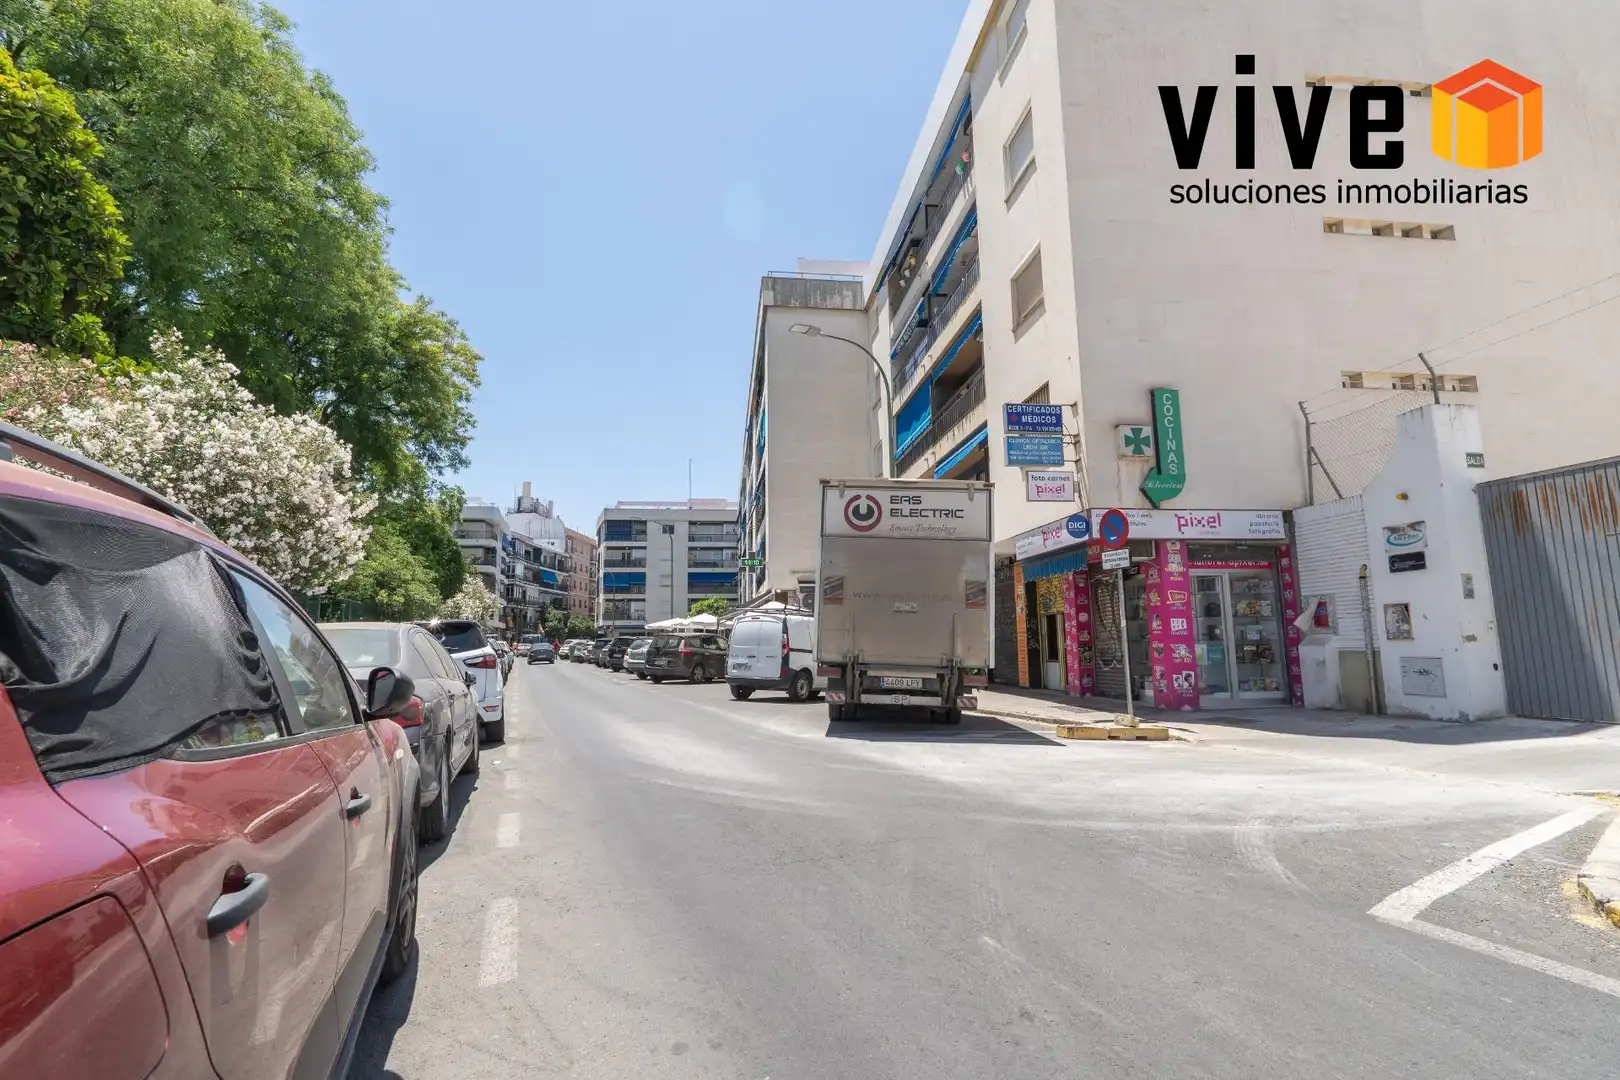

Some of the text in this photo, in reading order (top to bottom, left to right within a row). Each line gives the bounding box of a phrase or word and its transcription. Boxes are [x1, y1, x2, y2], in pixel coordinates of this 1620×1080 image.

[1007, 405, 1061, 414] CERTIFICADOS
[1021, 413, 1057, 423] MÉDICOS
[1163, 393, 1178, 475] COCINAS
[1035, 483, 1065, 498] pixel
[890, 495, 922, 505] EAS
[890, 508, 965, 518] ELECTRIC
[1068, 521, 1086, 529] DIGI
[1174, 512, 1222, 535] pixel
[1041, 522, 1062, 549] pixel
